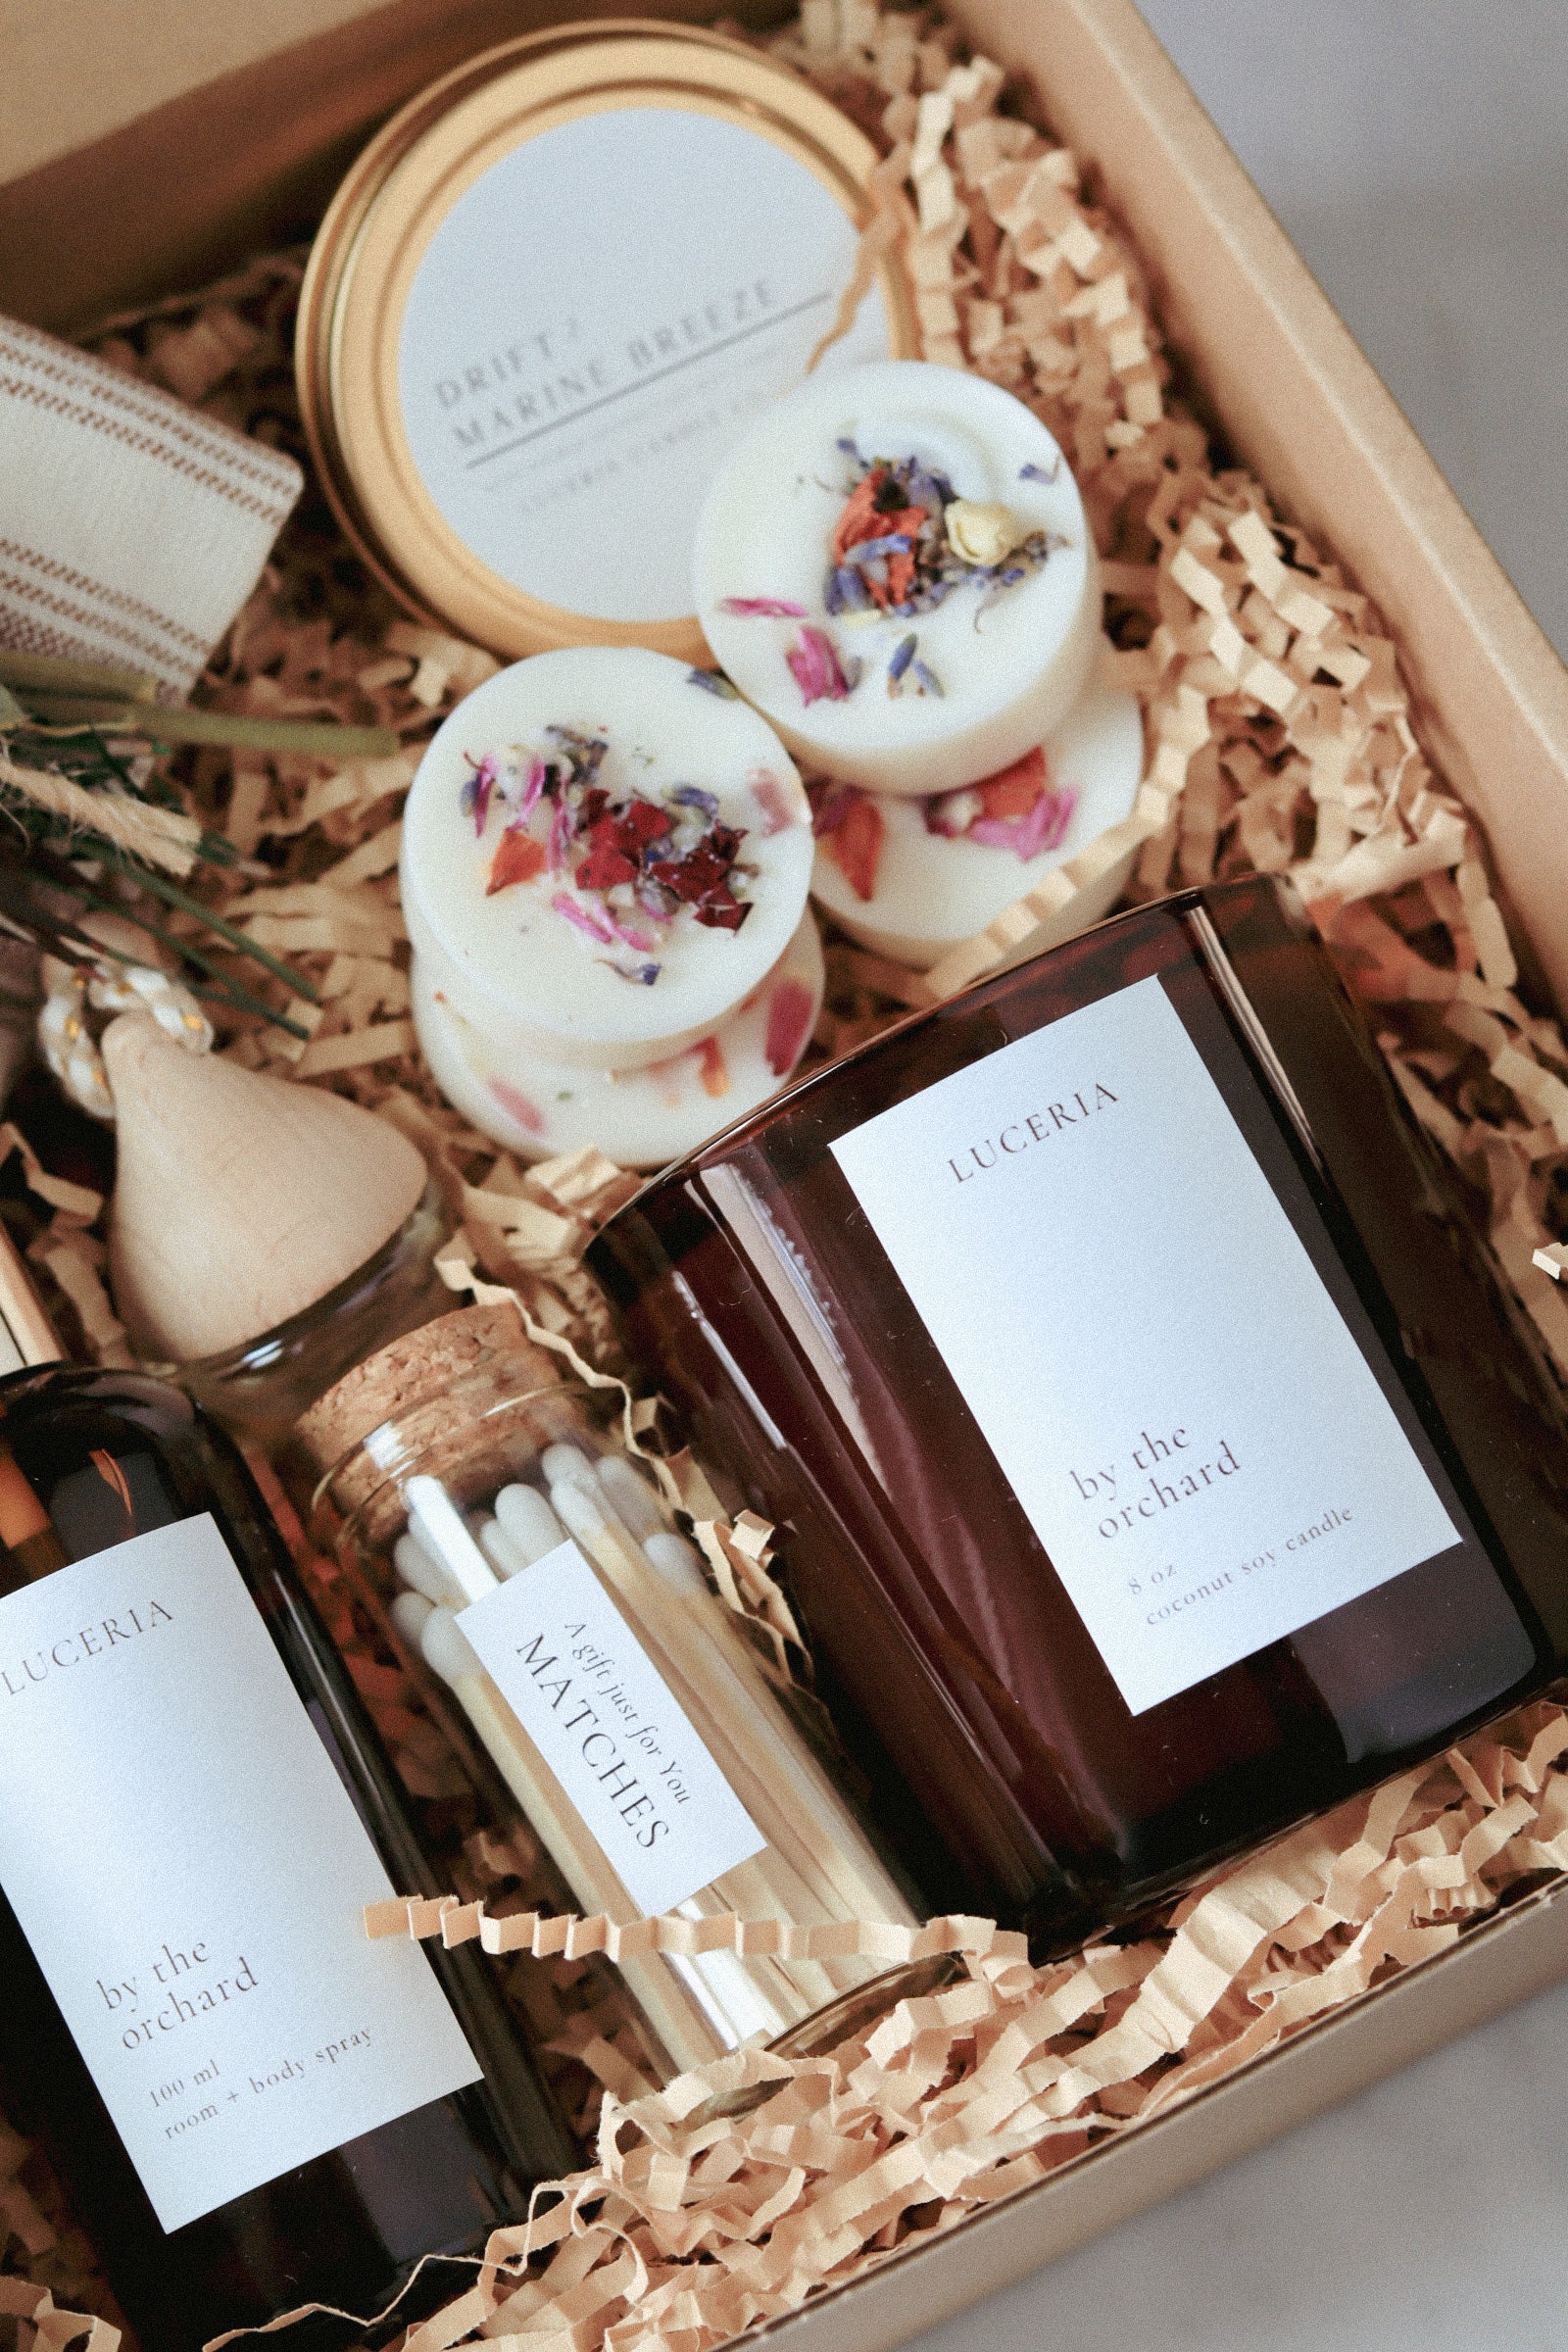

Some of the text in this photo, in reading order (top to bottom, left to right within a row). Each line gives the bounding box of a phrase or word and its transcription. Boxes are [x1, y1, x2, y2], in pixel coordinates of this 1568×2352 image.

[433, 334, 556, 410] DRIFT
[453, 358, 612, 449] MARINE
[626, 279, 777, 368] BREEZE
[948, 1082, 1120, 1183] LUCERIA
[1069, 1427, 1192, 1501] by the
[1098, 1440, 1242, 1539] orchard
[1128, 1564, 1178, 1595] 8 oz
[1146, 1505, 1354, 1626] coconut soy candle
[1, 1600, 173, 1695] LUCERIA
[515, 1634, 669, 1848] MATCHES
[564, 1622, 691, 1804] A gift just for You
[96, 1942, 210, 2013] by the
[122, 1956, 260, 2050] orchard
[149, 2059, 221, 2108] 100 ml
[165, 2027, 372, 2140] room + body spray
